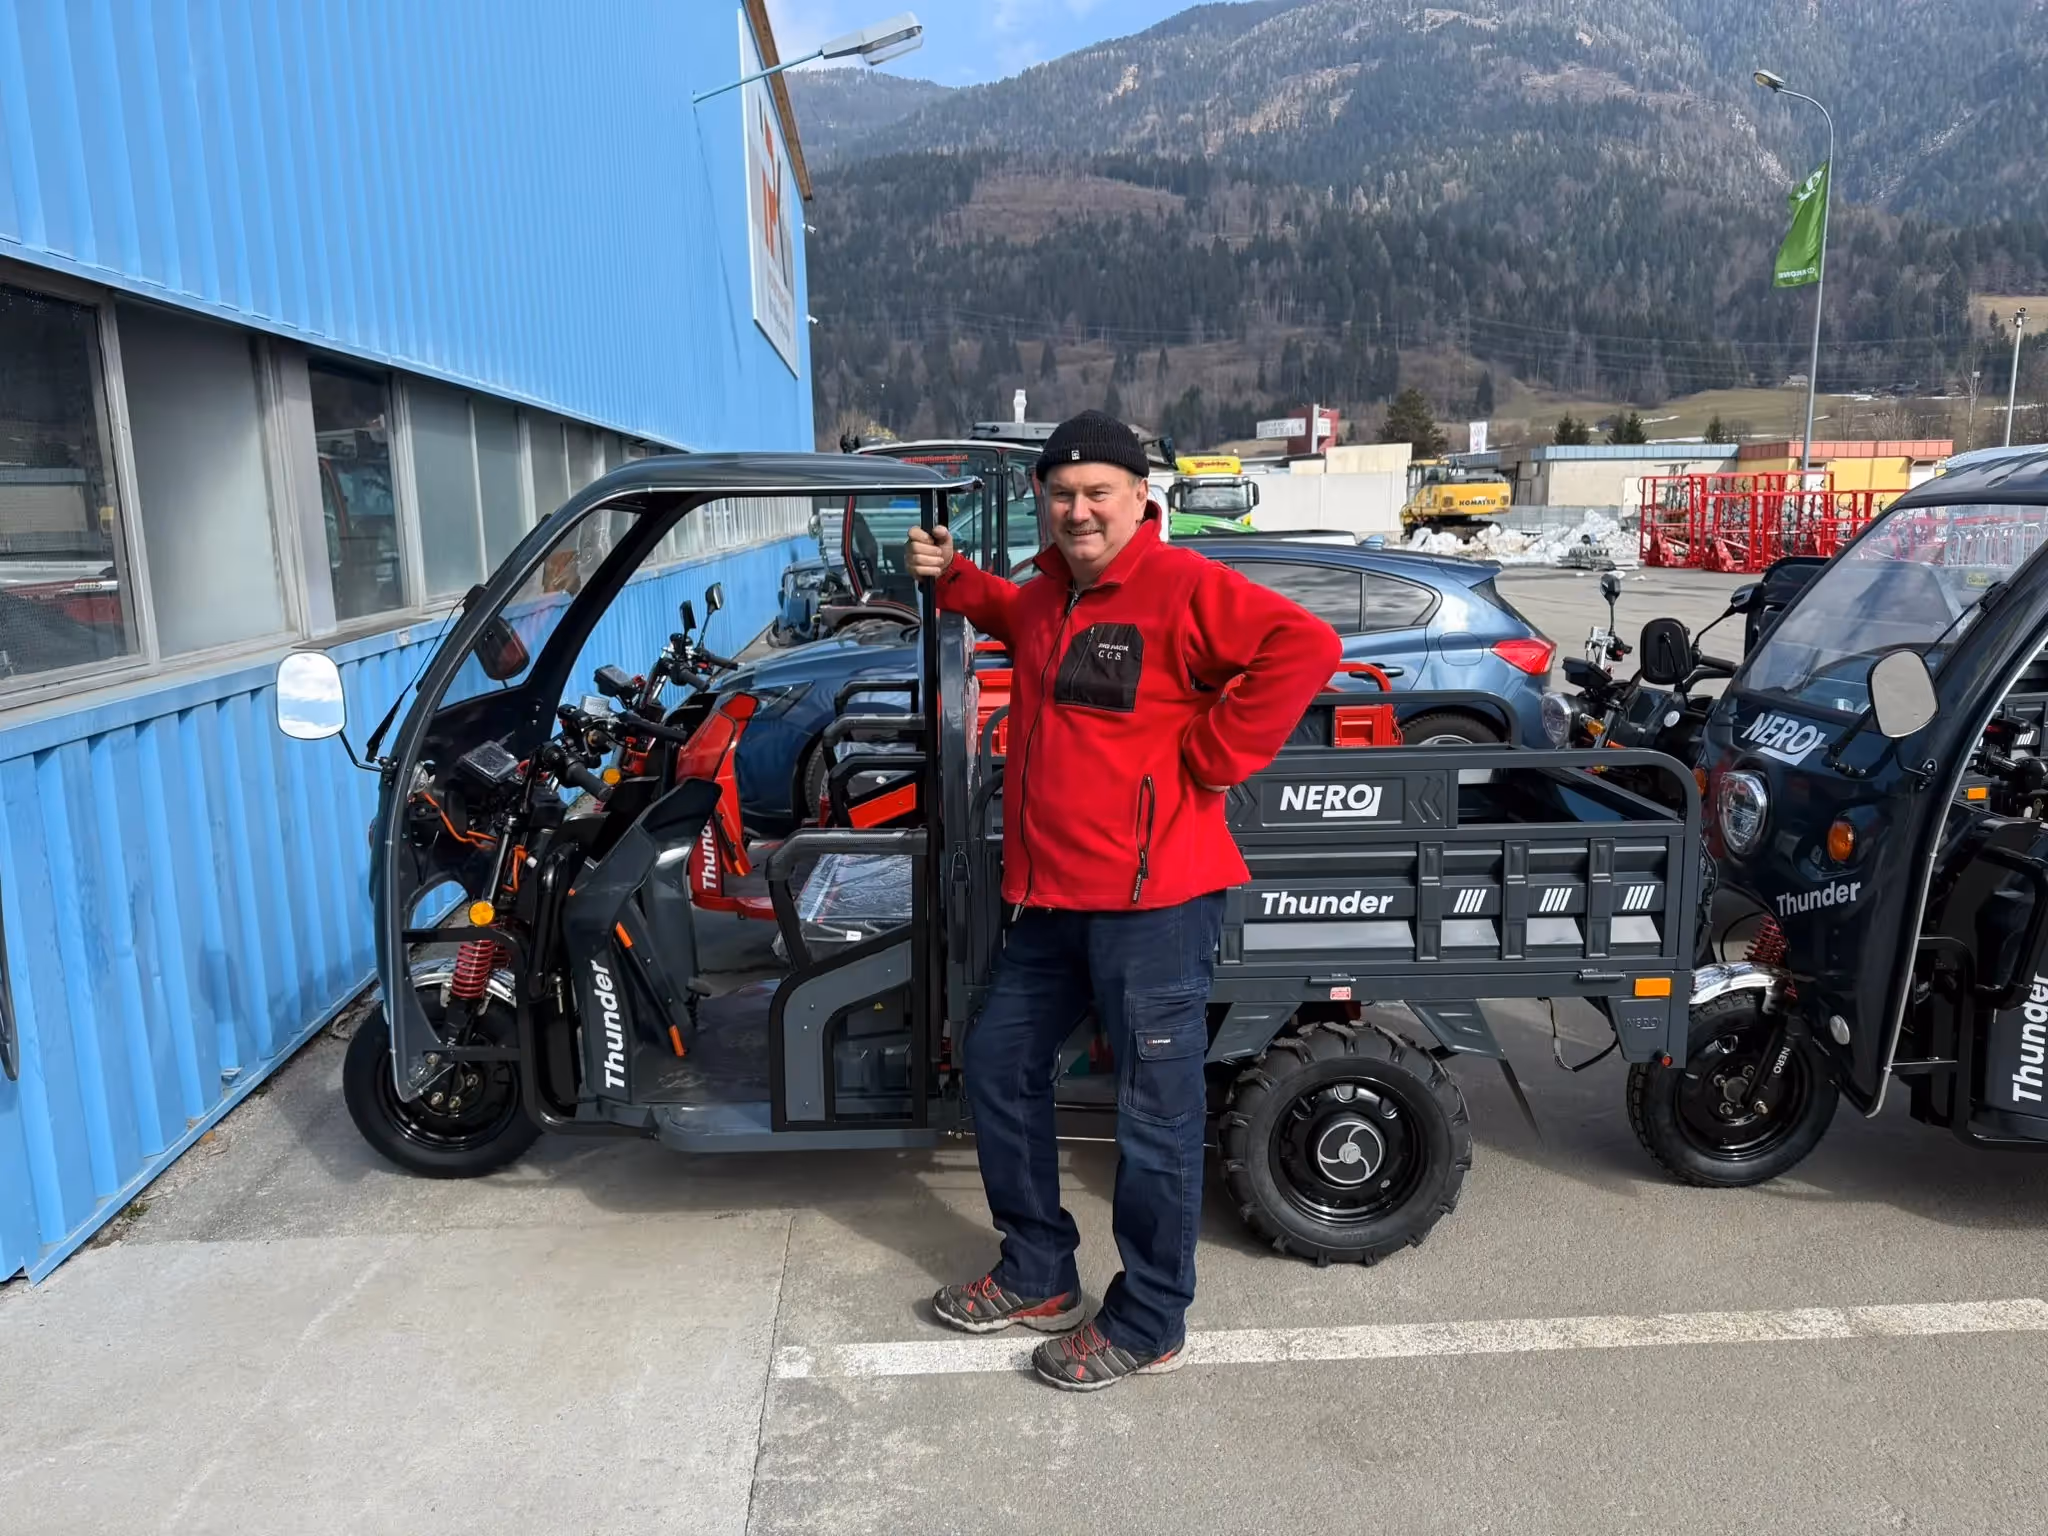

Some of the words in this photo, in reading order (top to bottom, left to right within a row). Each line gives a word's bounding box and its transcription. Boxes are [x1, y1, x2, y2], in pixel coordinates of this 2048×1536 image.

[1740, 712, 1823, 758] NERO
[1279, 783, 1379, 813] NERO
[1261, 891, 1393, 915] Thunder
[1776, 881, 1861, 917] Thunder
[590, 959, 625, 1089] Thunder
[1773, 1046, 1791, 1074] NERO
